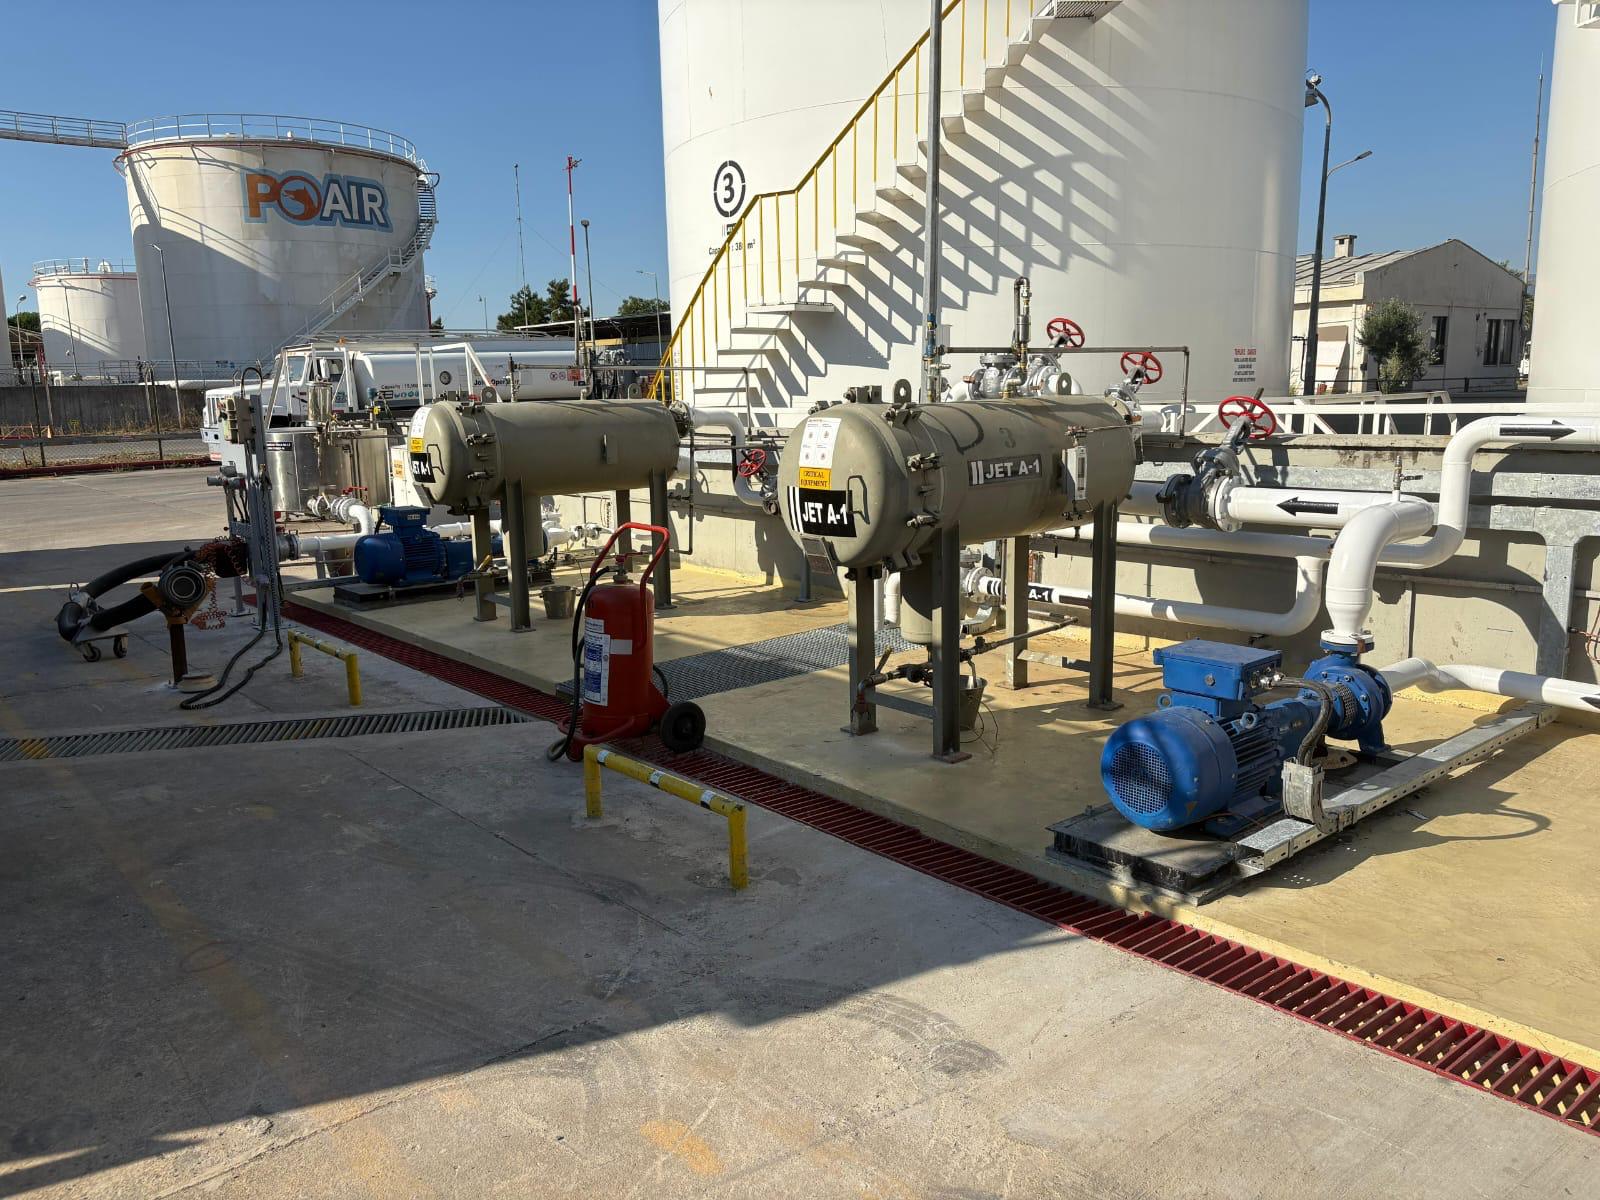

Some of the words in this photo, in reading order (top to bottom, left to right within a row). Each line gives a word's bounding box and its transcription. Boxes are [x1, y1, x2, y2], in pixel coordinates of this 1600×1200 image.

[723, 172, 735, 204] 3
[804, 470, 825, 479] CRITICAL
[985, 462, 1013, 479] JET
[1018, 458, 1040, 475] A-1
[800, 479, 828, 488] EQUIPMENT
[802, 501, 823, 524] JET
[827, 503, 848, 525] A-1
[1028, 588, 1049, 602] A-1
